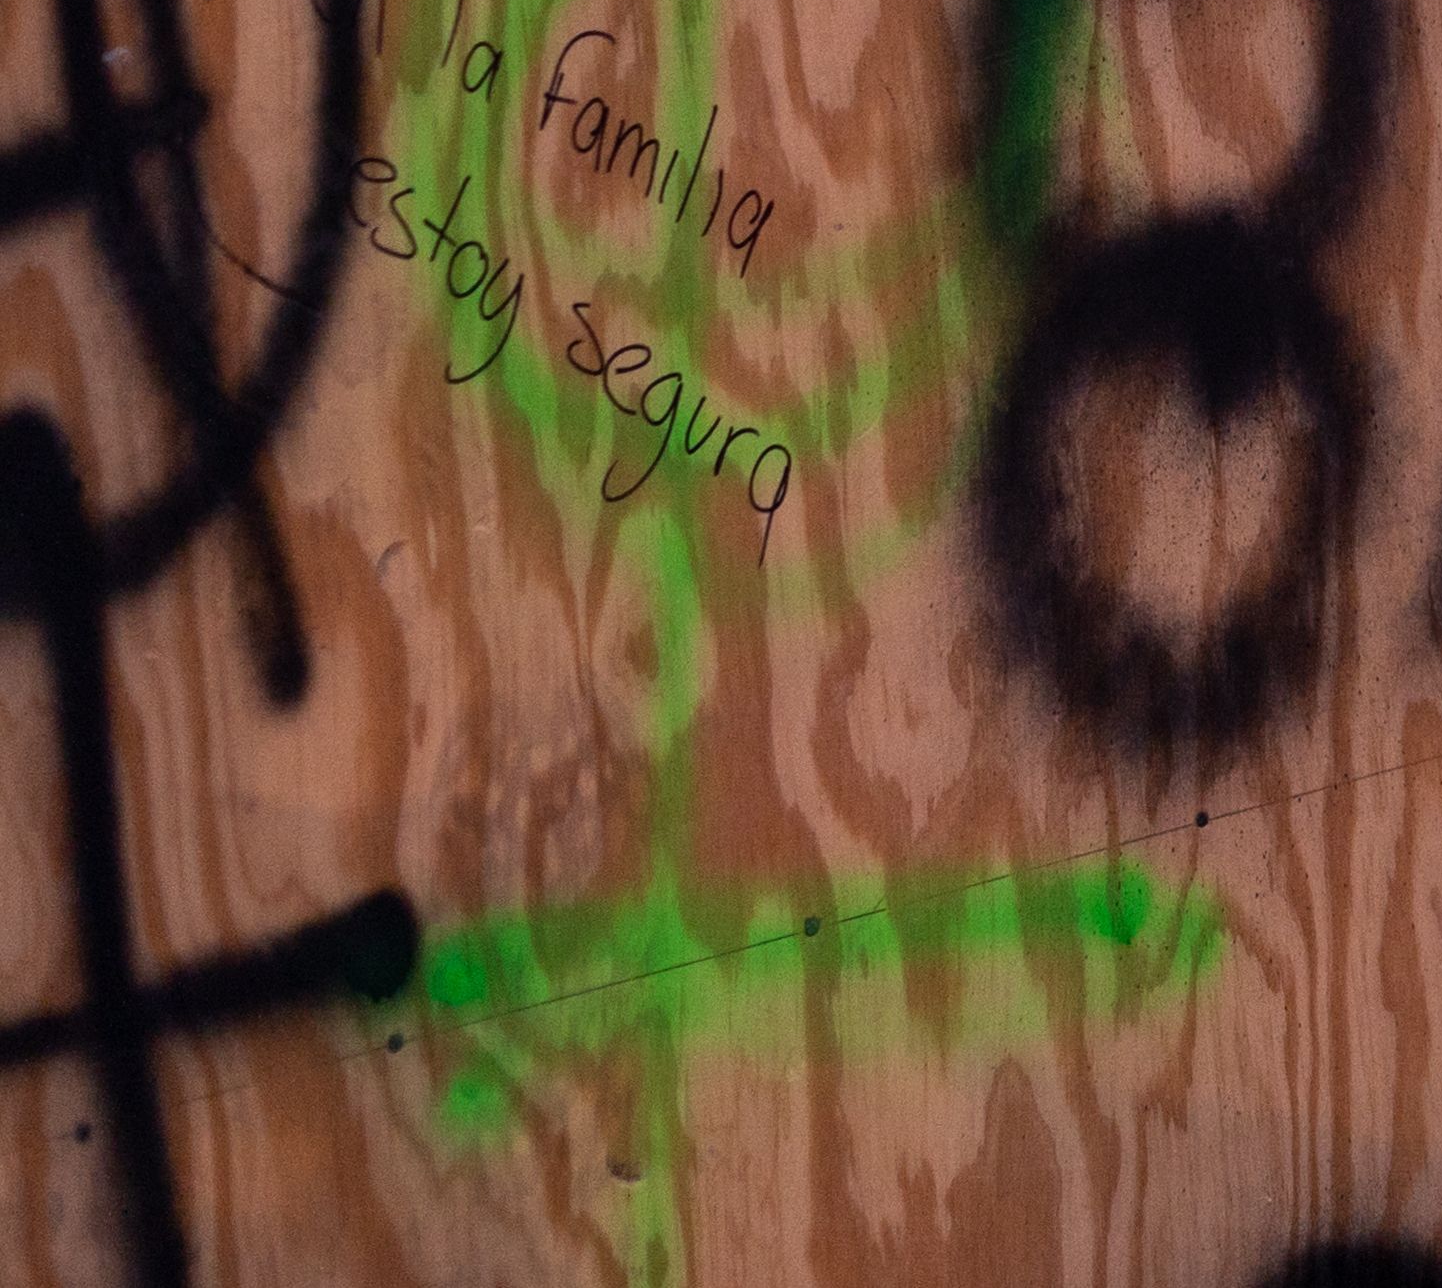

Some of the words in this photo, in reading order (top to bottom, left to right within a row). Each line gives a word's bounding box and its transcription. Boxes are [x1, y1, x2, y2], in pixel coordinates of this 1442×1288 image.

[538, 27, 777, 283] familia
[350, 153, 526, 387] estoy
[563, 300, 797, 573] segura
